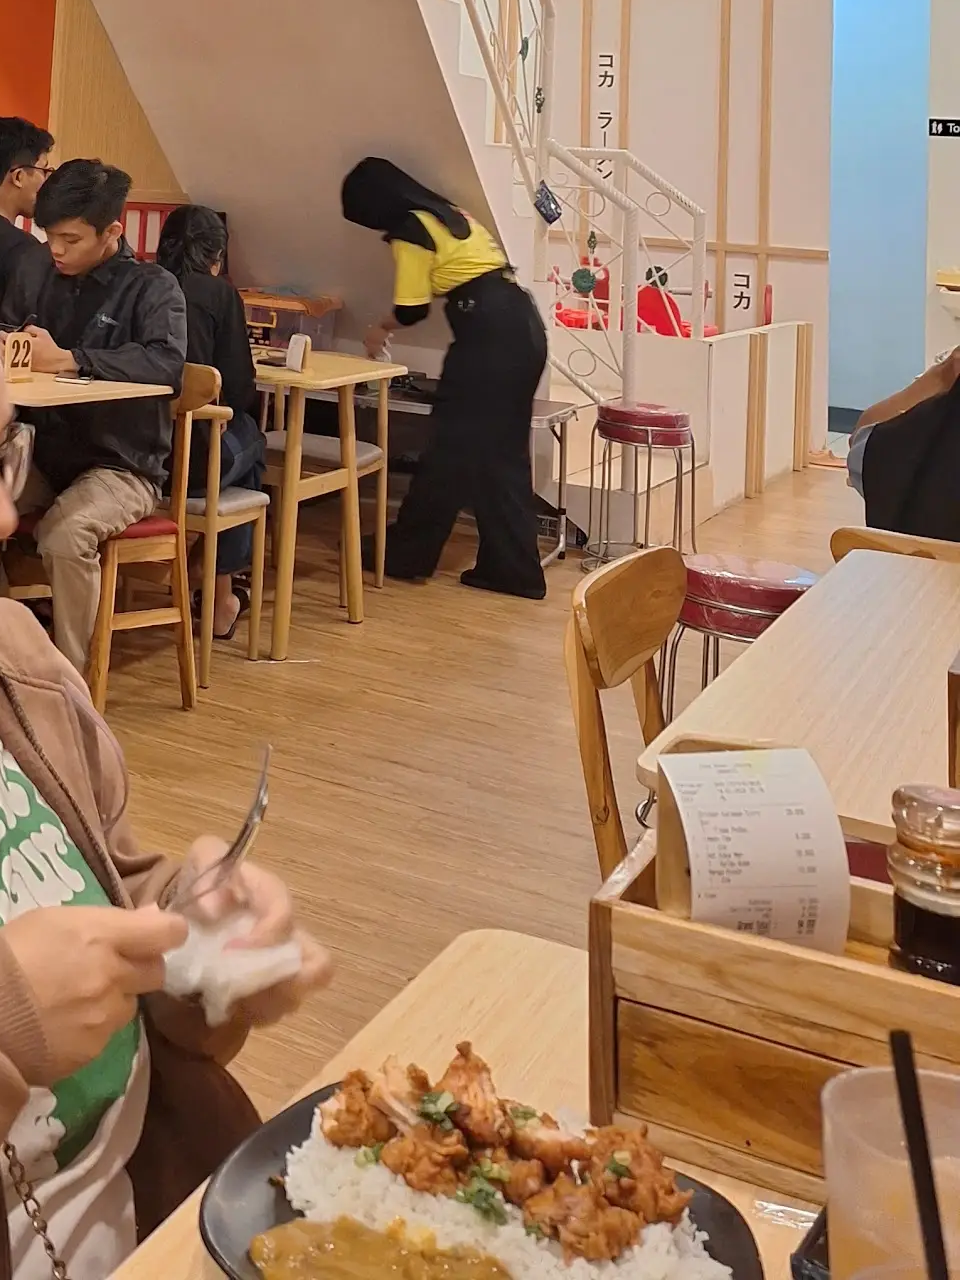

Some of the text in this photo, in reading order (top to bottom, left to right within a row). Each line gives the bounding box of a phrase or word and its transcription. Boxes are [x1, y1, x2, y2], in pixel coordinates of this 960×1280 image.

[598, 54, 615, 88] コカ
[733, 273, 751, 310] コカ
[10, 339, 31, 368] 22
